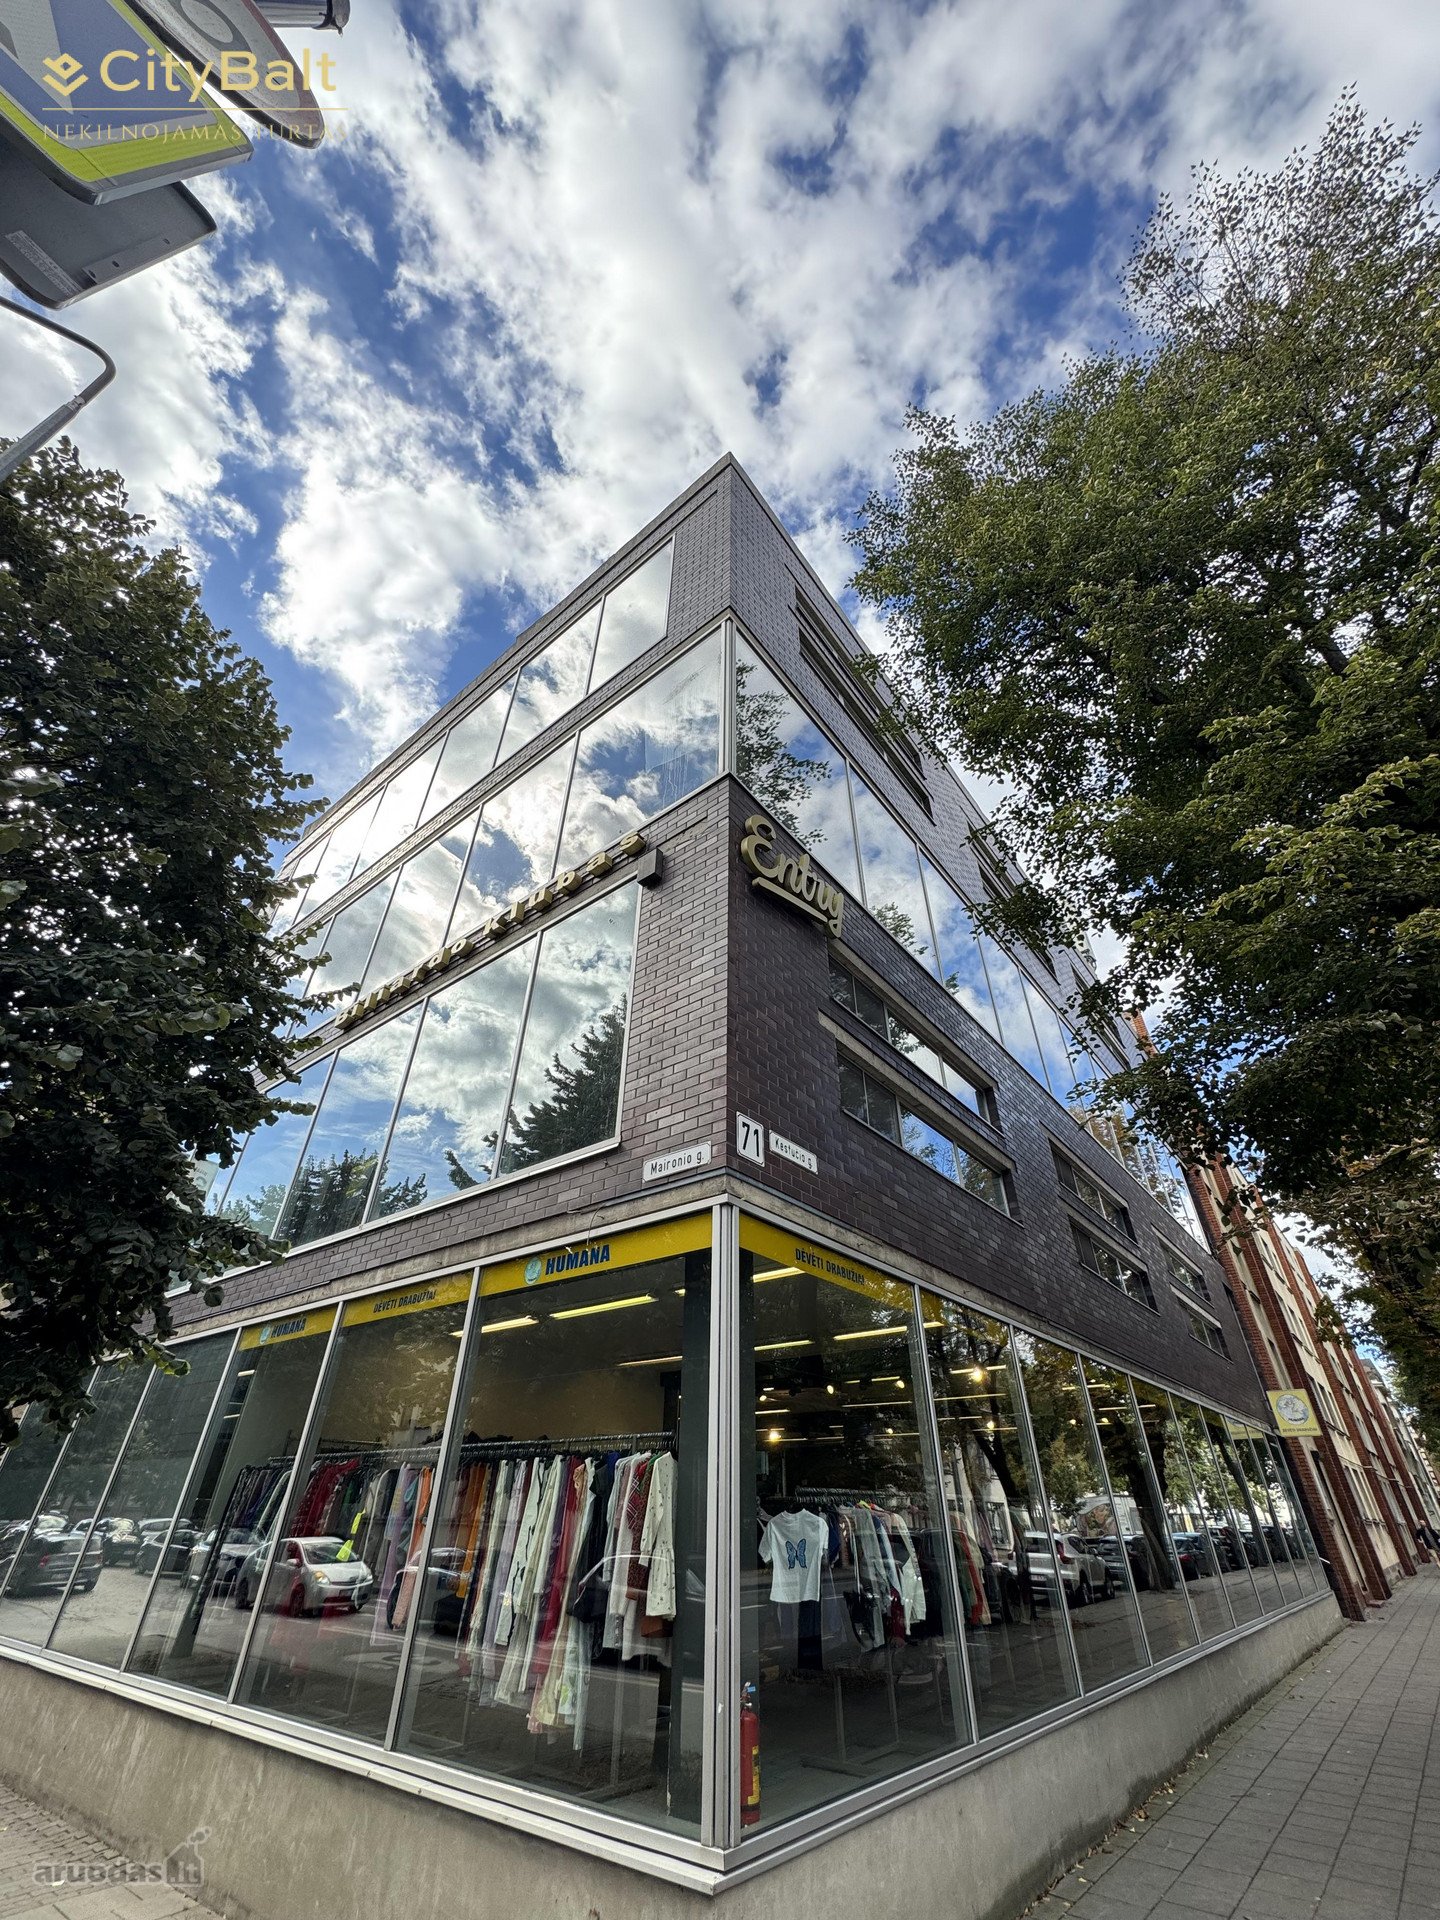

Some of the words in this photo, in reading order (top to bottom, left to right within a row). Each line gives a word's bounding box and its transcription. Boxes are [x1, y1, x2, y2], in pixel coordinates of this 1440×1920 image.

[742, 1121, 760, 1158] 71
[650, 1152, 692, 1175] Maironio
[696, 1151, 704, 1164] g.
[544, 1244, 611, 1276] HUMANA
